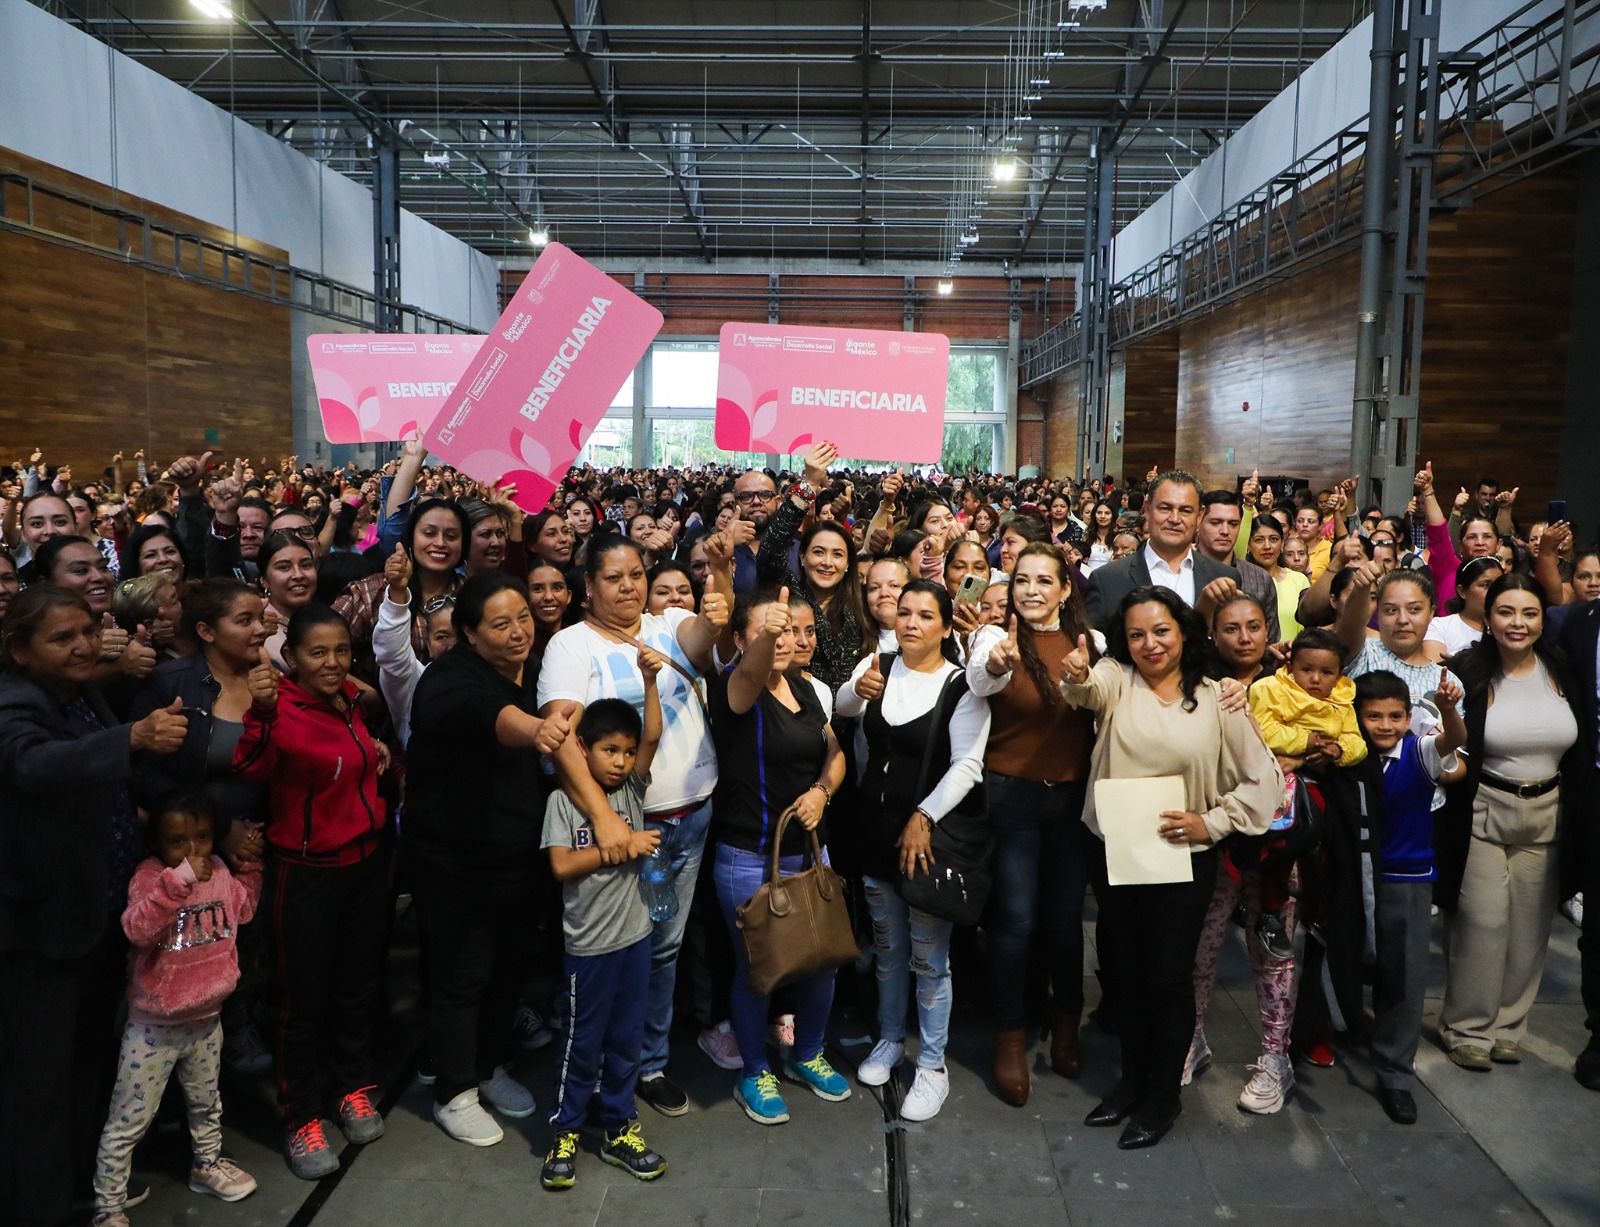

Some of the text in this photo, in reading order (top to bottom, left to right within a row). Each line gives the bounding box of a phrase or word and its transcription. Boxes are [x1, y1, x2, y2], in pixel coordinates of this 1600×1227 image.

[504, 313, 524, 341] gigante
[513, 314, 533, 341] México
[786, 341, 815, 349] Desarrollo
[845, 340, 875, 349] gigante
[850, 348, 877, 356] México
[519, 296, 613, 422] BENEFICIARIA
[473, 369, 494, 396] Desarrollo
[490, 353, 503, 370] Social
[791, 386, 927, 413] BENEFICIARIA
